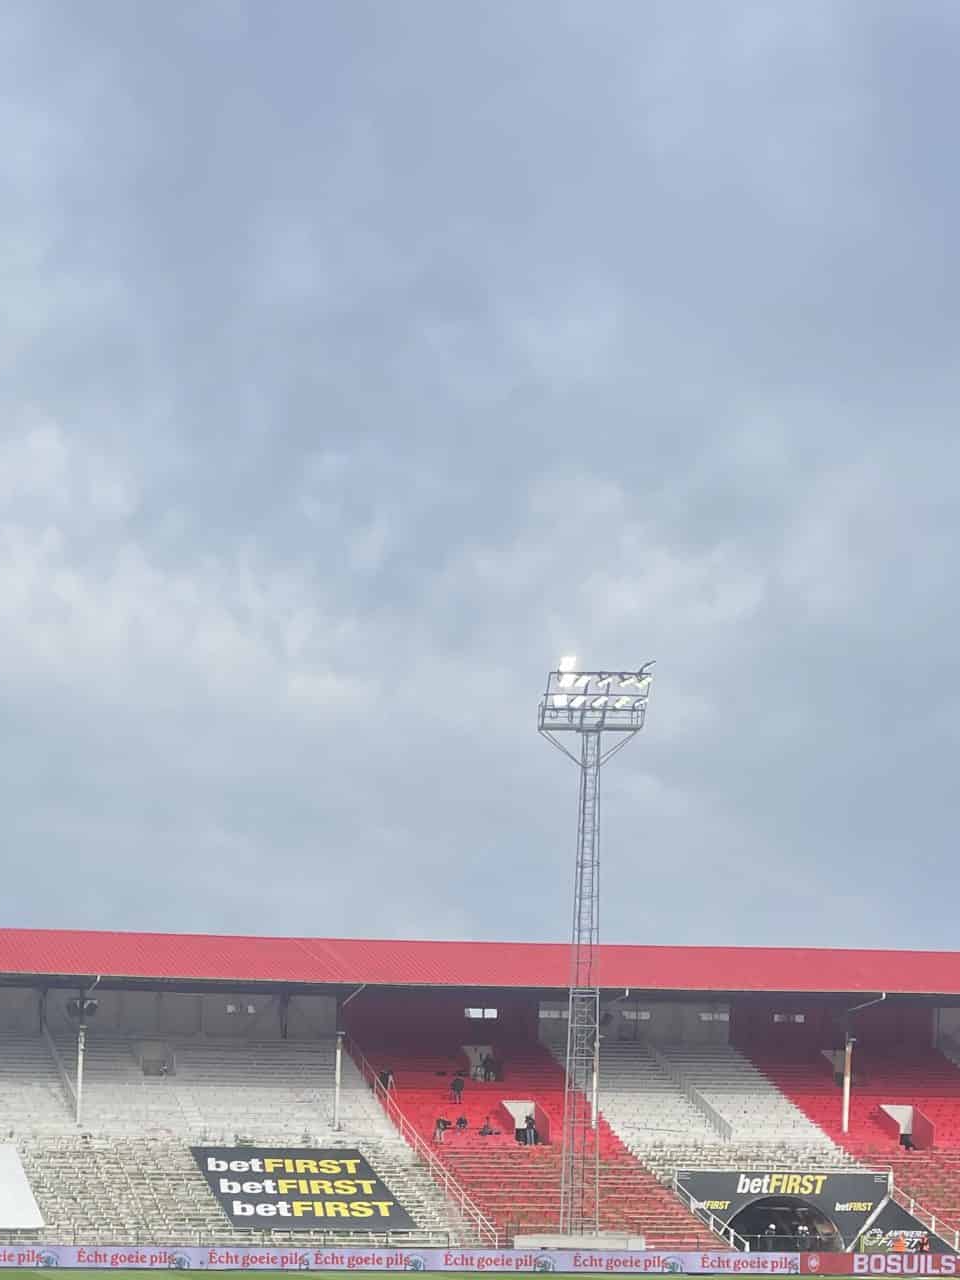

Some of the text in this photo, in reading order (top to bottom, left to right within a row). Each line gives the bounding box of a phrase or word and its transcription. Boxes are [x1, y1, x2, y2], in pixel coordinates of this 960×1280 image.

[207, 1157, 361, 1174] betFIRST
[219, 1178, 377, 1195] betFIRST
[737, 1173, 827, 1195] betFIRST
[232, 1200, 394, 1217] betFIRST
[111, 1249, 146, 1267] goeie
[242, 1250, 277, 1267] goeie
[347, 1251, 383, 1268] goeie
[477, 1254, 513, 1270] goeie
[606, 1254, 641, 1271] goeie
[739, 1256, 769, 1272] goeie
[854, 1253, 960, 1274] BOSUILS
